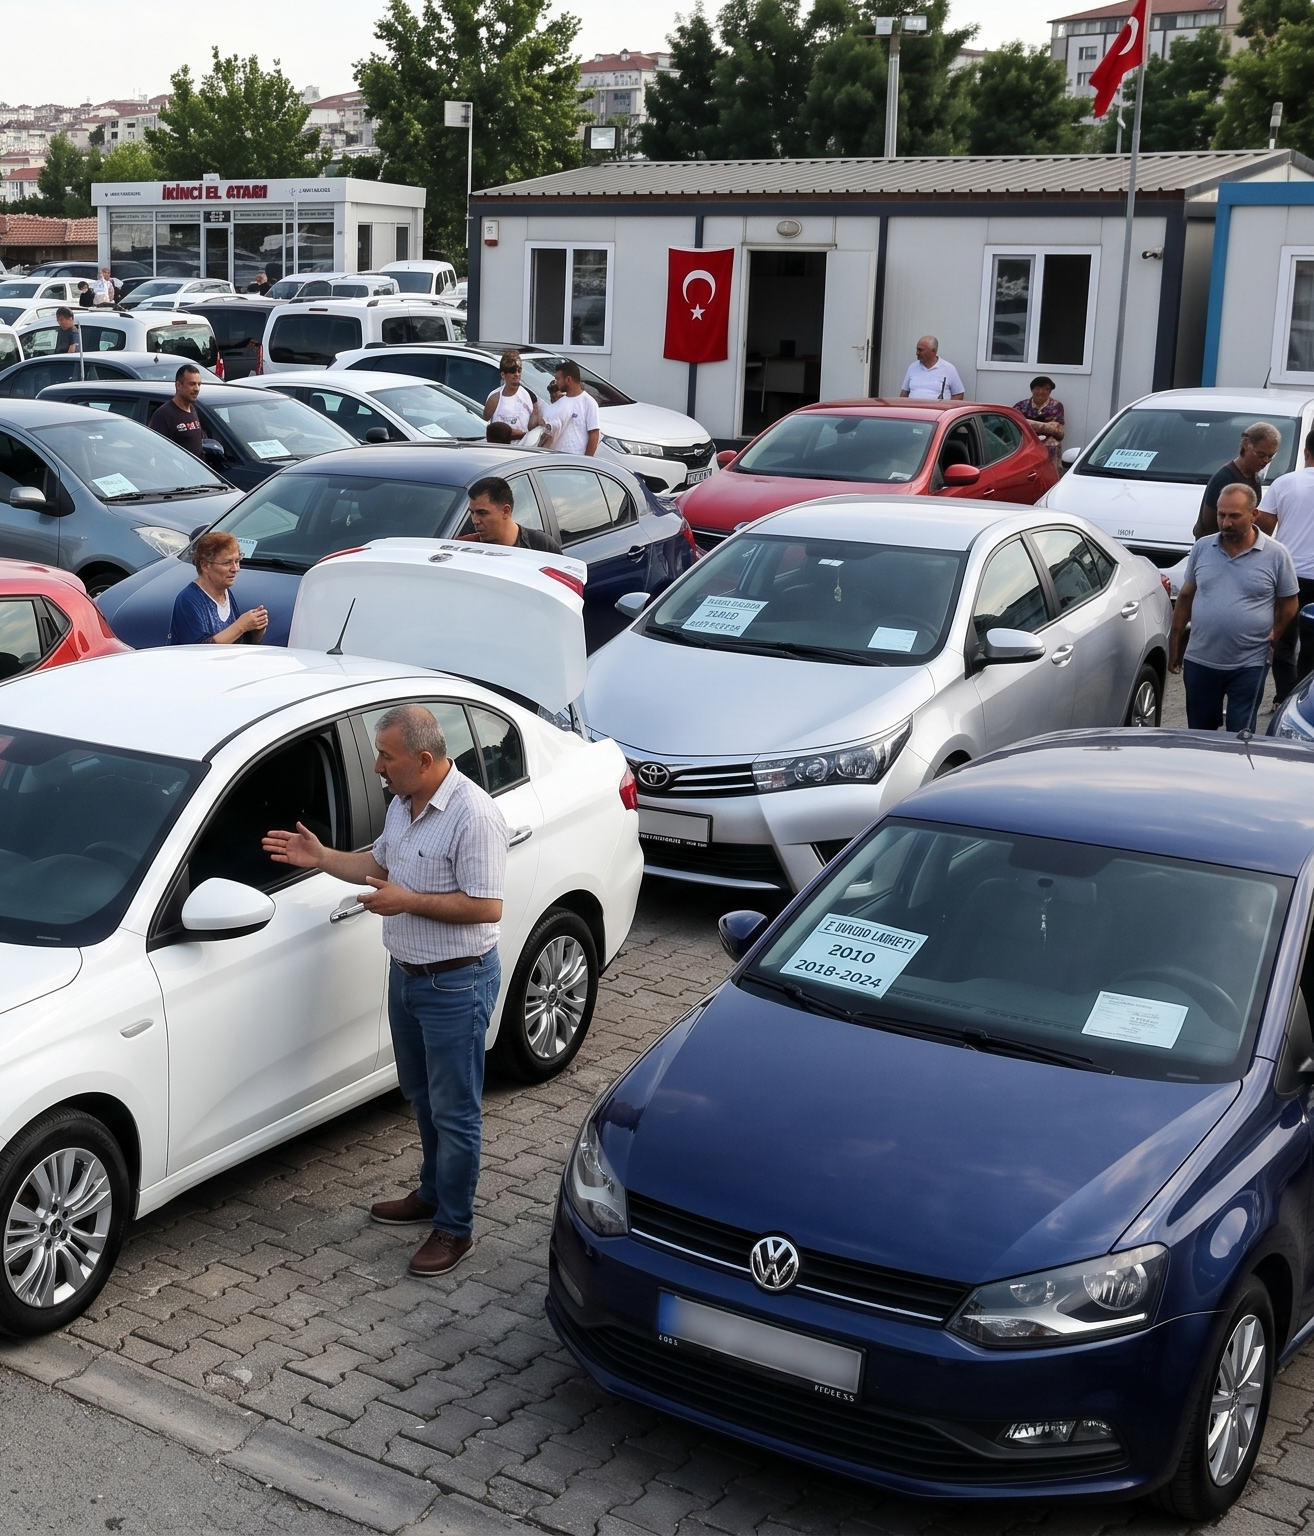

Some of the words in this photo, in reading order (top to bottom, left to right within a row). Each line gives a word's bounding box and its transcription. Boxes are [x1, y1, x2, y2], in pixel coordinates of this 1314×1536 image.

[162, 183, 203, 200] İKİNCİ
[205, 185, 222, 200] EL
[827, 943, 876, 965] 2010
[793, 959, 883, 989] 2018-2024
